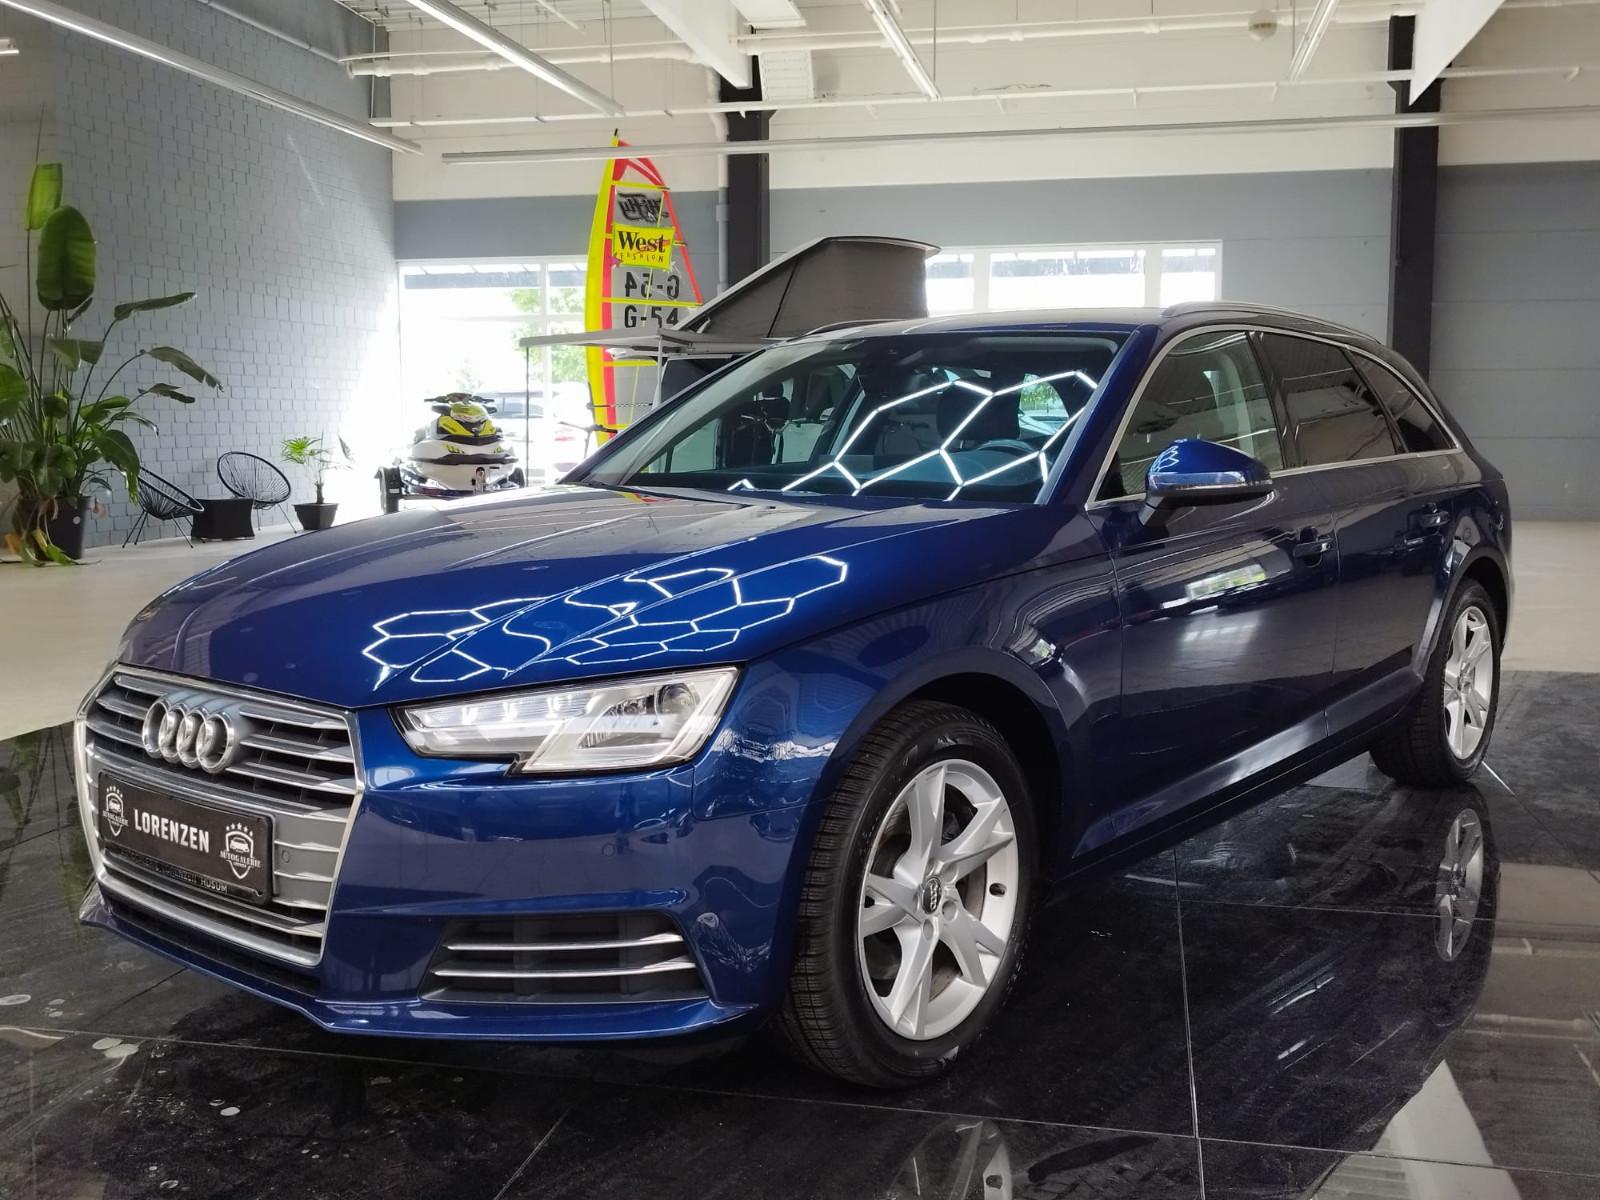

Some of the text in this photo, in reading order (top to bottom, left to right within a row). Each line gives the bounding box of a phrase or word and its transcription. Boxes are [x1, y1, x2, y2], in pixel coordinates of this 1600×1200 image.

[617, 230, 665, 253] West
[624, 304, 679, 329] G-54
[134, 808, 209, 853] LORENZEN
[219, 850, 261, 868] AUTOGALERIE
